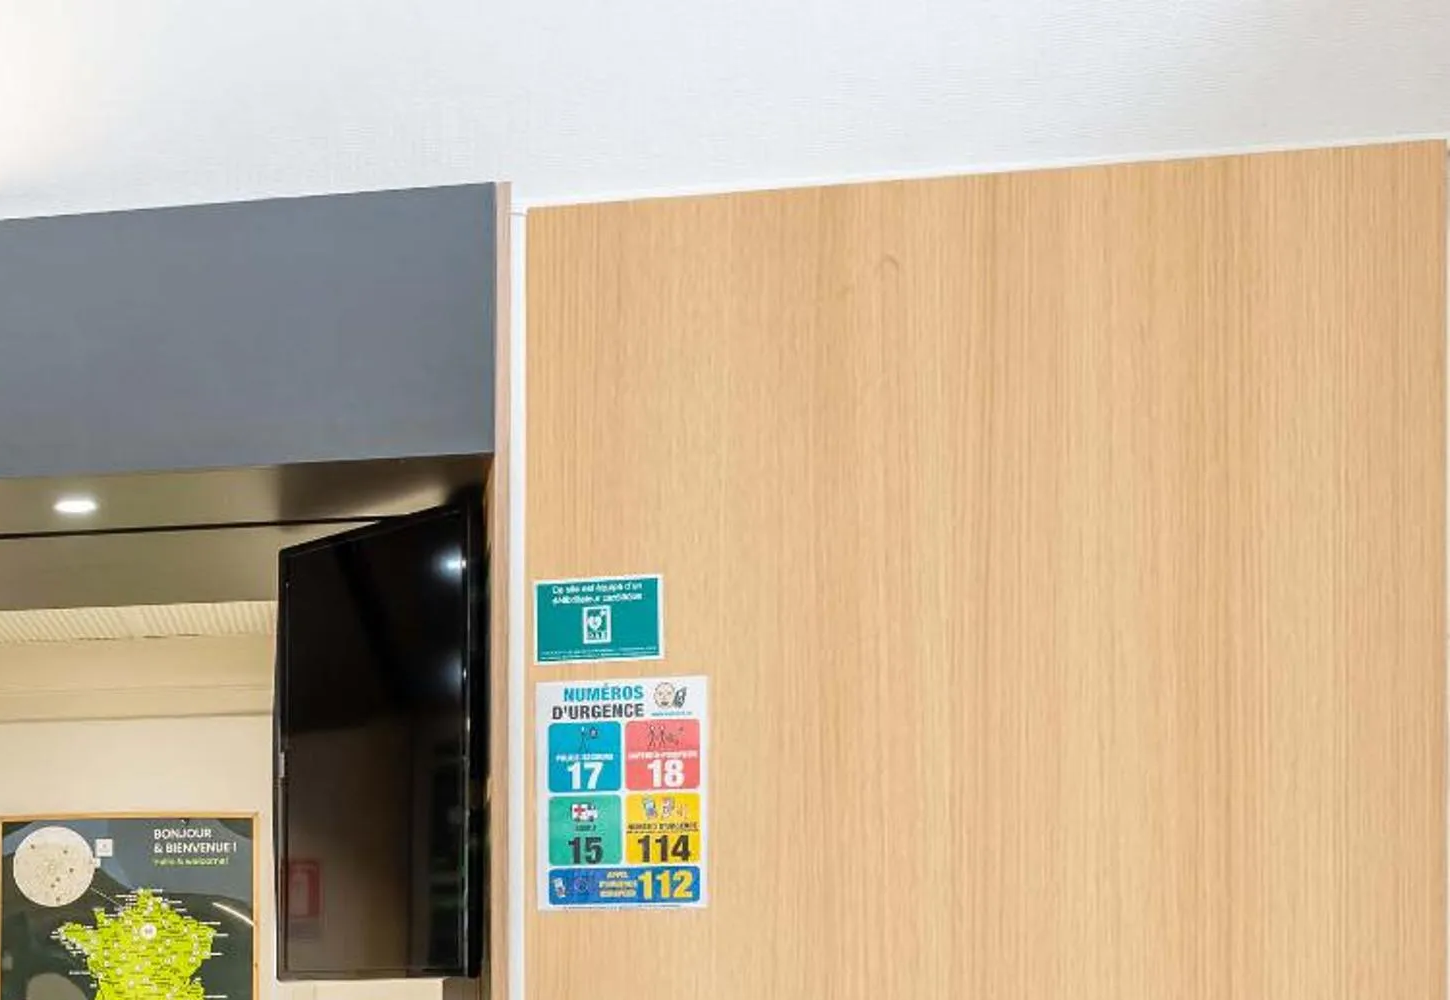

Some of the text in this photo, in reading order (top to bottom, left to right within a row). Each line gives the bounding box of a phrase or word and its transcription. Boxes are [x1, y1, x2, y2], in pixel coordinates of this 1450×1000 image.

[563, 683, 645, 702] NUMÉROS
[552, 703, 645, 720] D'URGENCE
[567, 761, 604, 790] 17
[647, 759, 685, 788] 18
[153, 828, 212, 840] BONJOUR
[165, 841, 231, 853] BIENVENUE
[568, 836, 604, 864] 15
[638, 834, 691, 863] 114
[638, 870, 693, 899] 112
